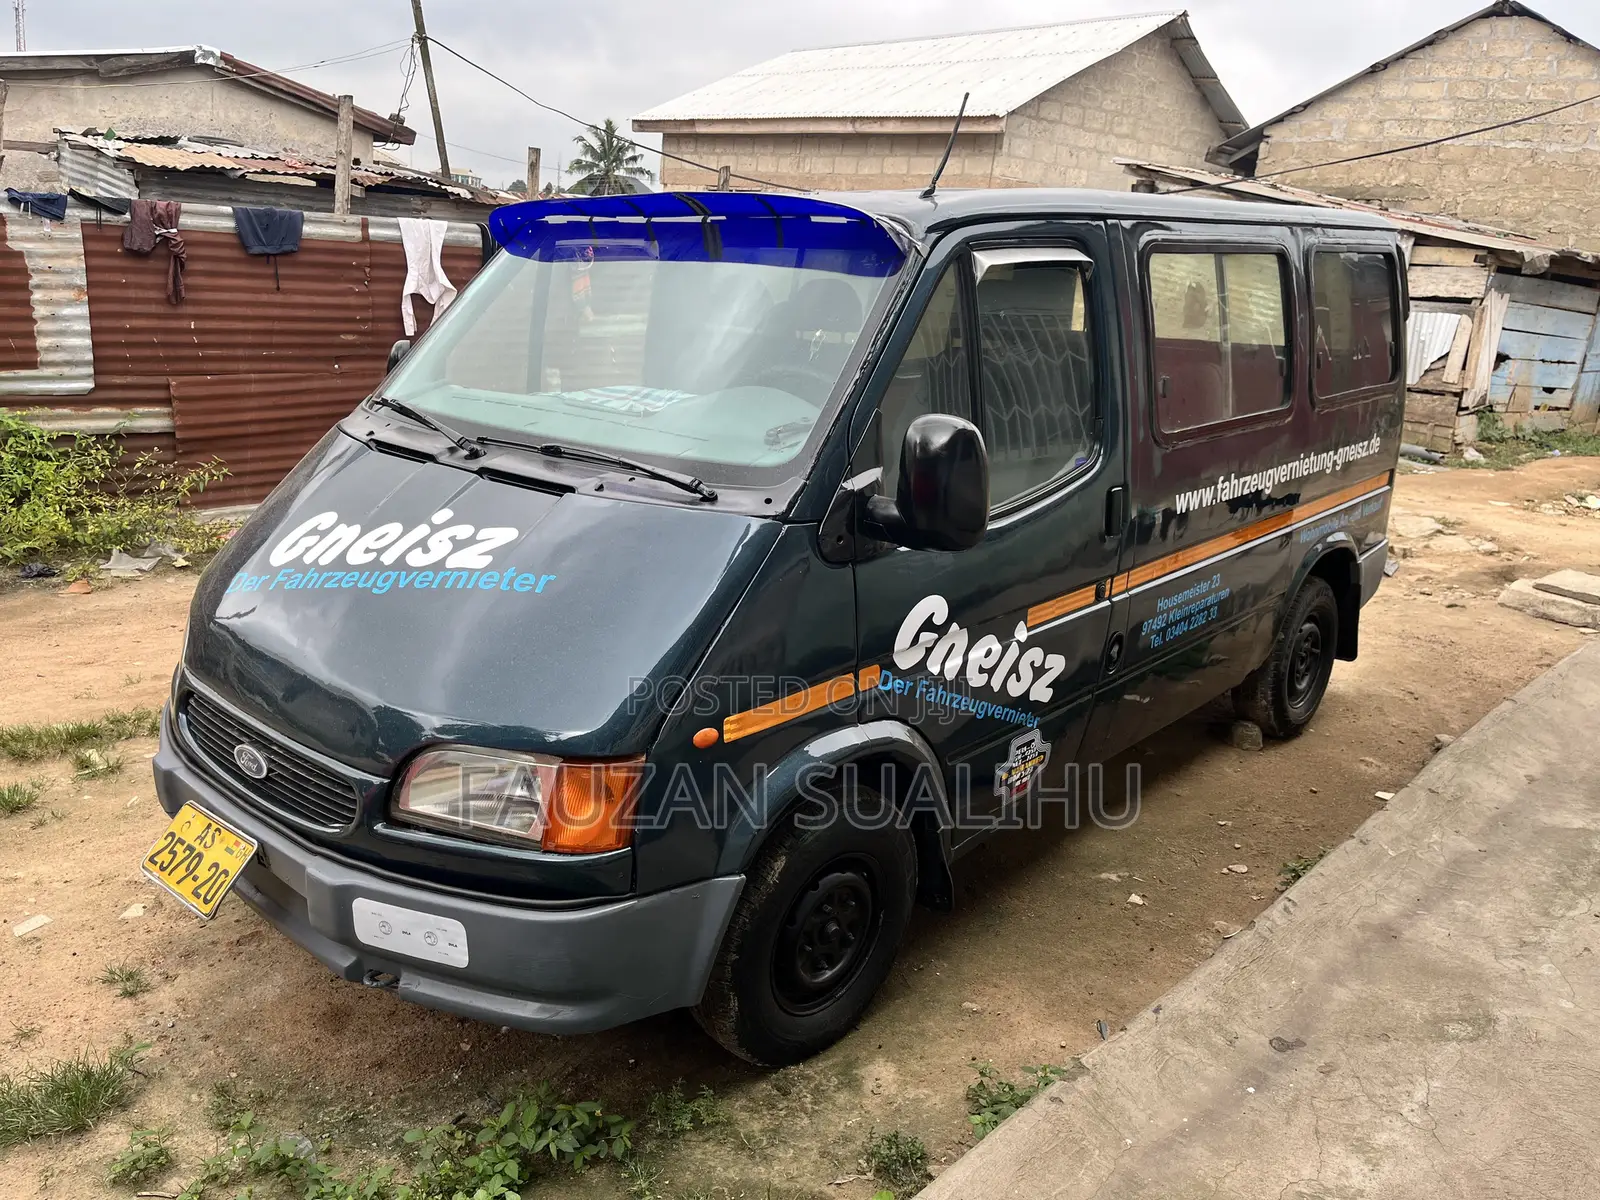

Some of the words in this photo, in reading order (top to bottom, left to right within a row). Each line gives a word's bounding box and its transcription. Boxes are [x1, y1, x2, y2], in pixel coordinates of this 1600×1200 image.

[269, 508, 519, 569] Gneisz
[225, 572, 270, 594] Der
[269, 566, 556, 594] Fahrzeugvernieter
[1211, 573, 1221, 589] 23
[1141, 613, 1168, 636] 97492
[893, 594, 1066, 703] Gneisz
[1150, 632, 1164, 649] Tel.
[878, 669, 914, 696] Der
[915, 679, 1040, 729] Fahrzeugvernieter
[194, 822, 222, 849] AS
[148, 831, 230, 905] 2579-20
